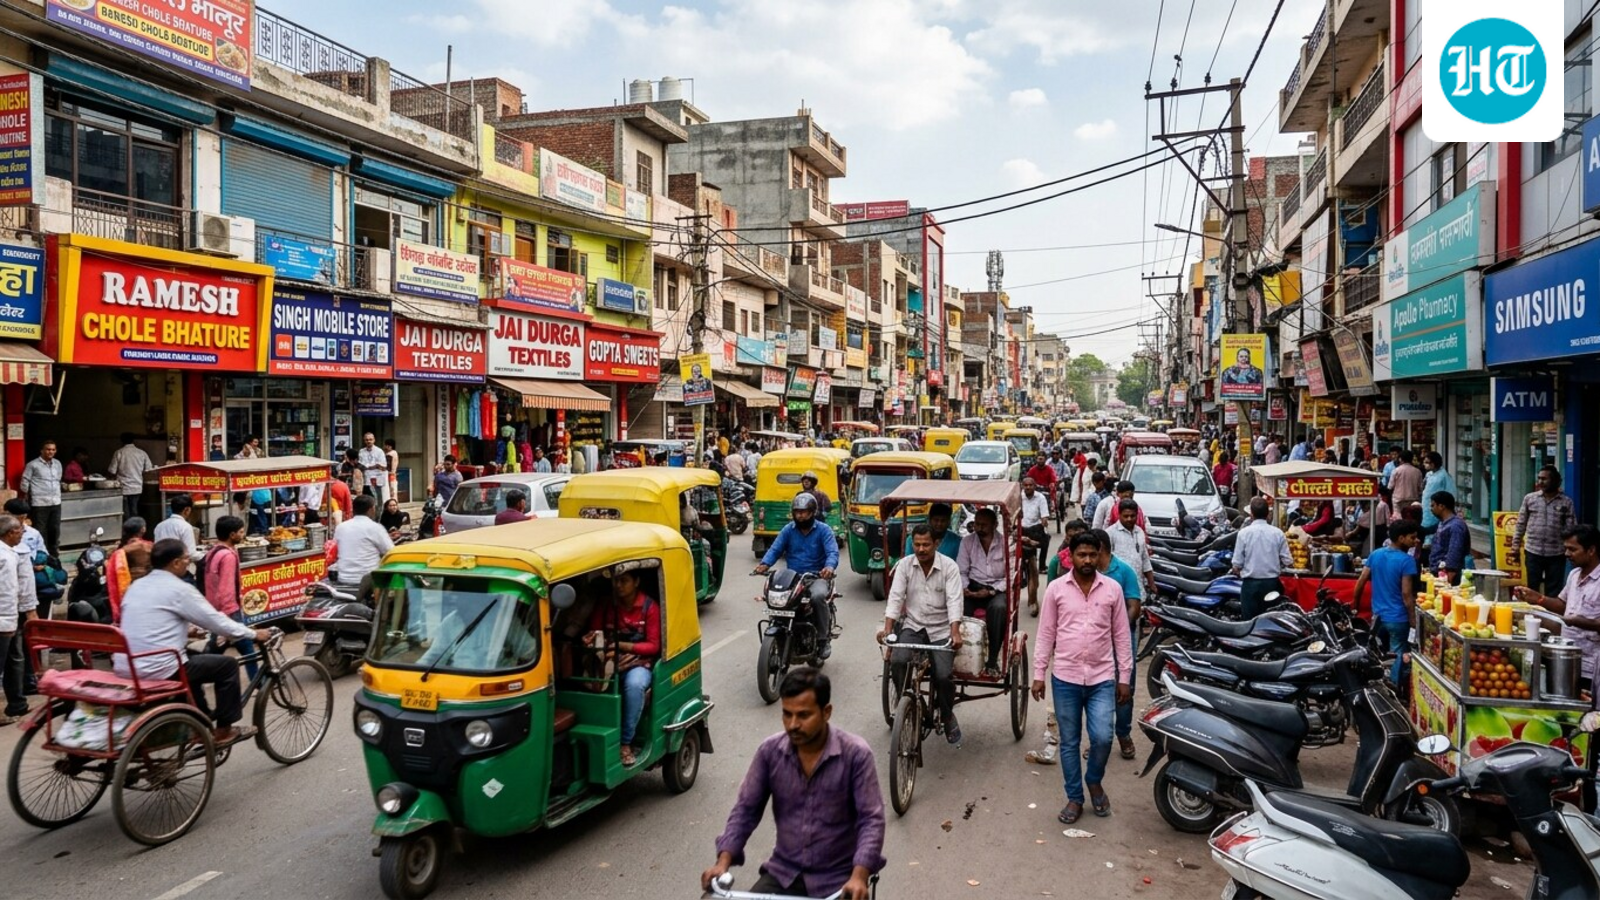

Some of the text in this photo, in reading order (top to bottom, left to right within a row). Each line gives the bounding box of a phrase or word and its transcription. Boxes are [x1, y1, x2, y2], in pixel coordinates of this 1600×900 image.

[1589, 135, 1600, 173] A
[102, 271, 239, 316] RAMESH
[1495, 279, 1585, 334] SAMSUNG
[83, 312, 250, 349] CHOLE BHATURE
[274, 303, 389, 338] SINGH MOBILE STORE
[494, 315, 582, 347] JAI DURGA
[400, 324, 483, 353] JAI DURGA
[412, 351, 472, 370] TEXTILES
[508, 346, 571, 368] TEXTILES
[1502, 391, 1547, 408] ATM
